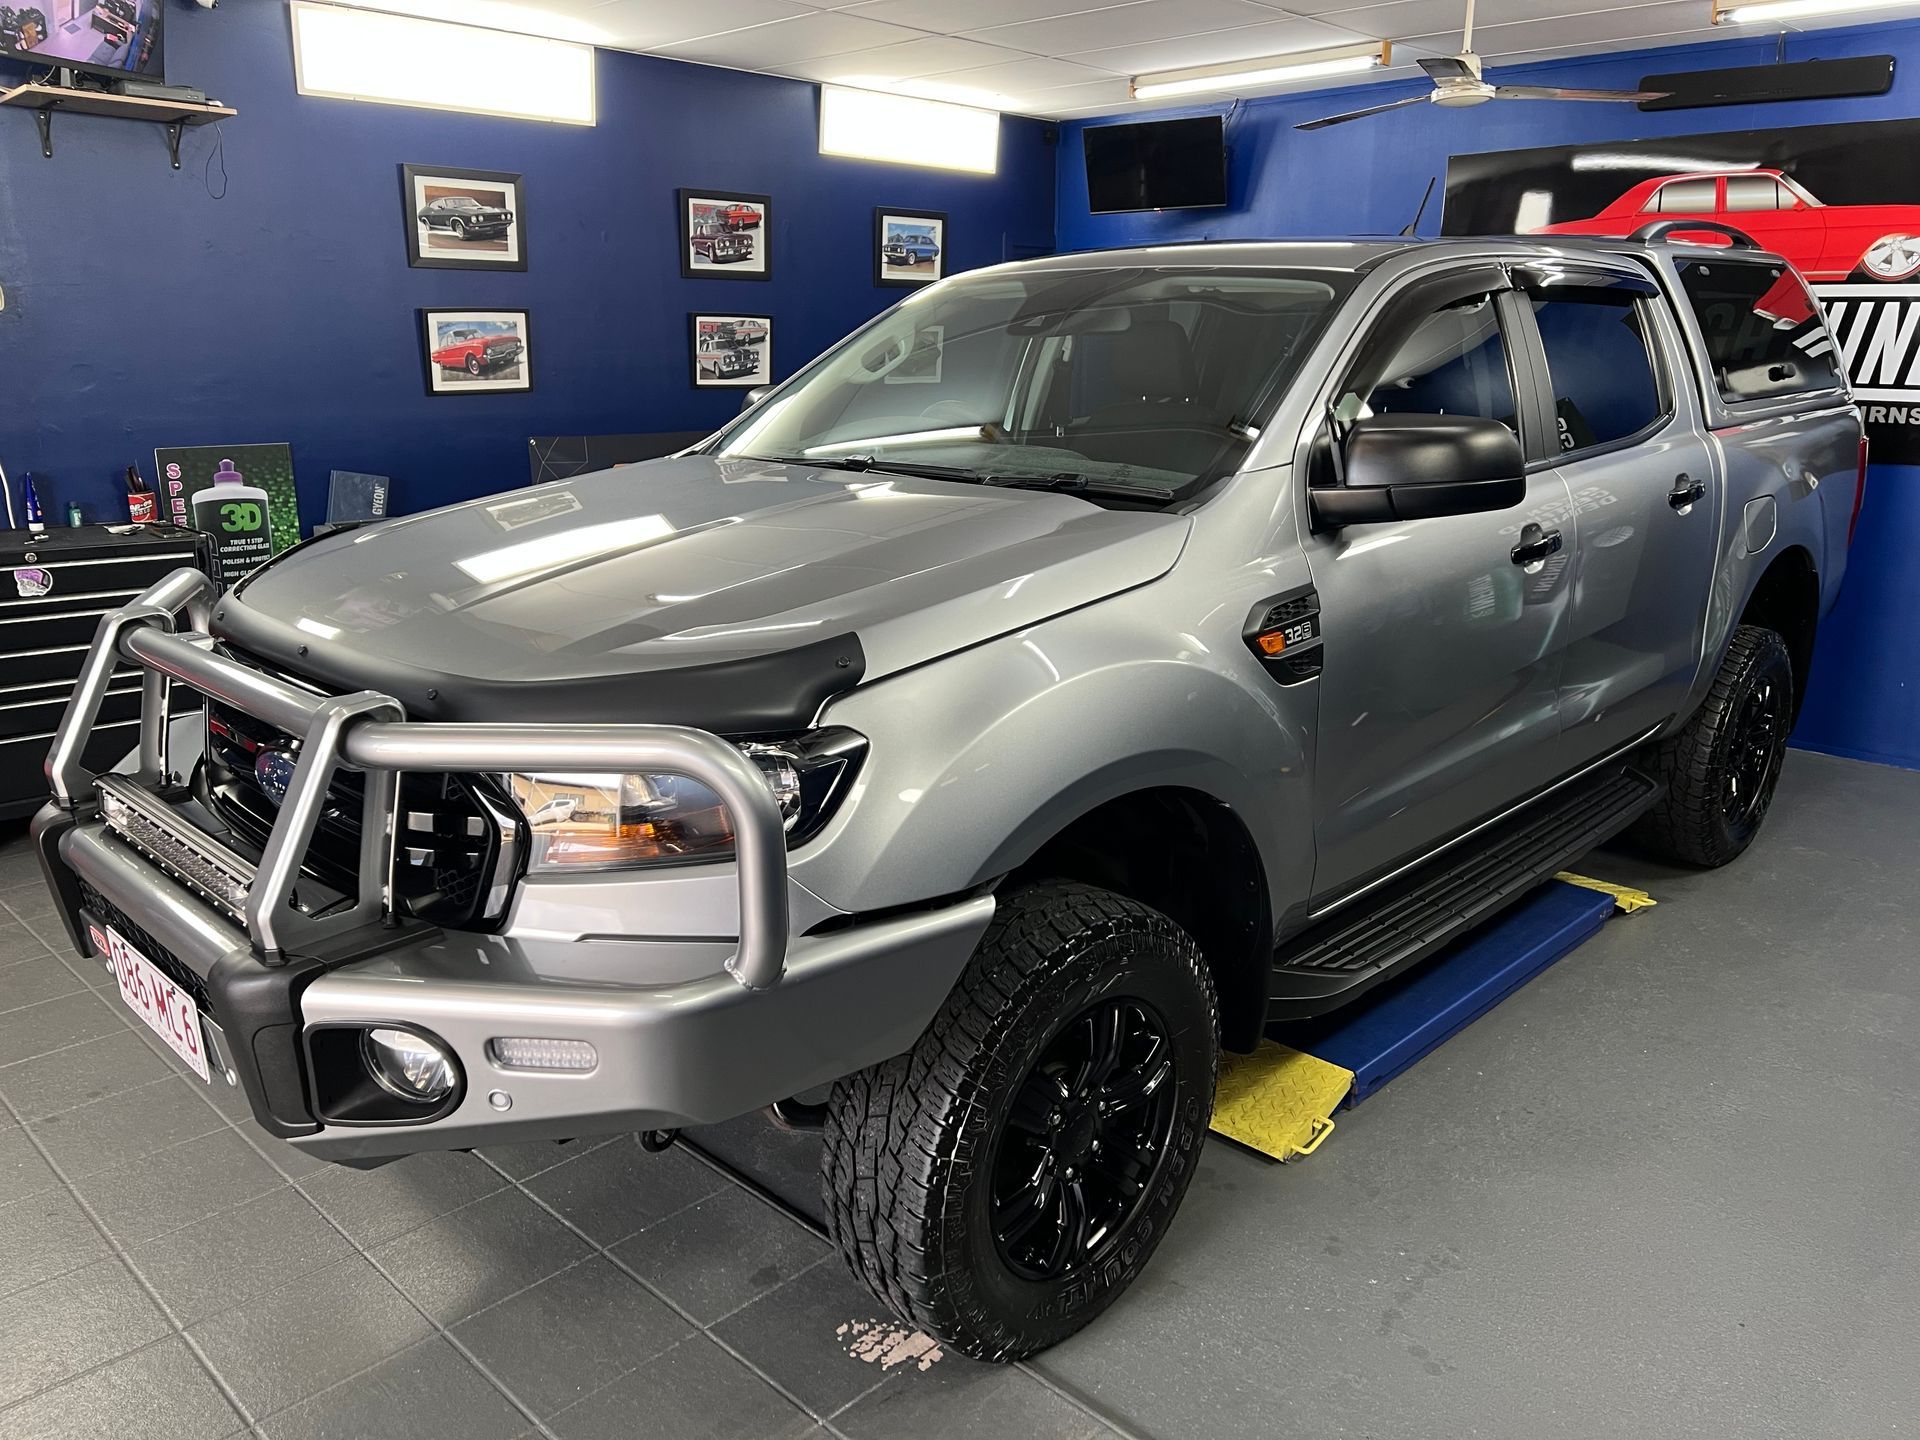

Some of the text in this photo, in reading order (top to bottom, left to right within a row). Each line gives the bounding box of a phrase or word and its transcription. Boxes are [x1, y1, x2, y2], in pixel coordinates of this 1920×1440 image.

[372, 486, 385, 515] GYEON
[220, 503, 262, 532] 3D
[230, 538, 246, 546] TRUE
[220, 544, 257, 553] CORRECTION
[223, 570, 239, 578] HIGH
